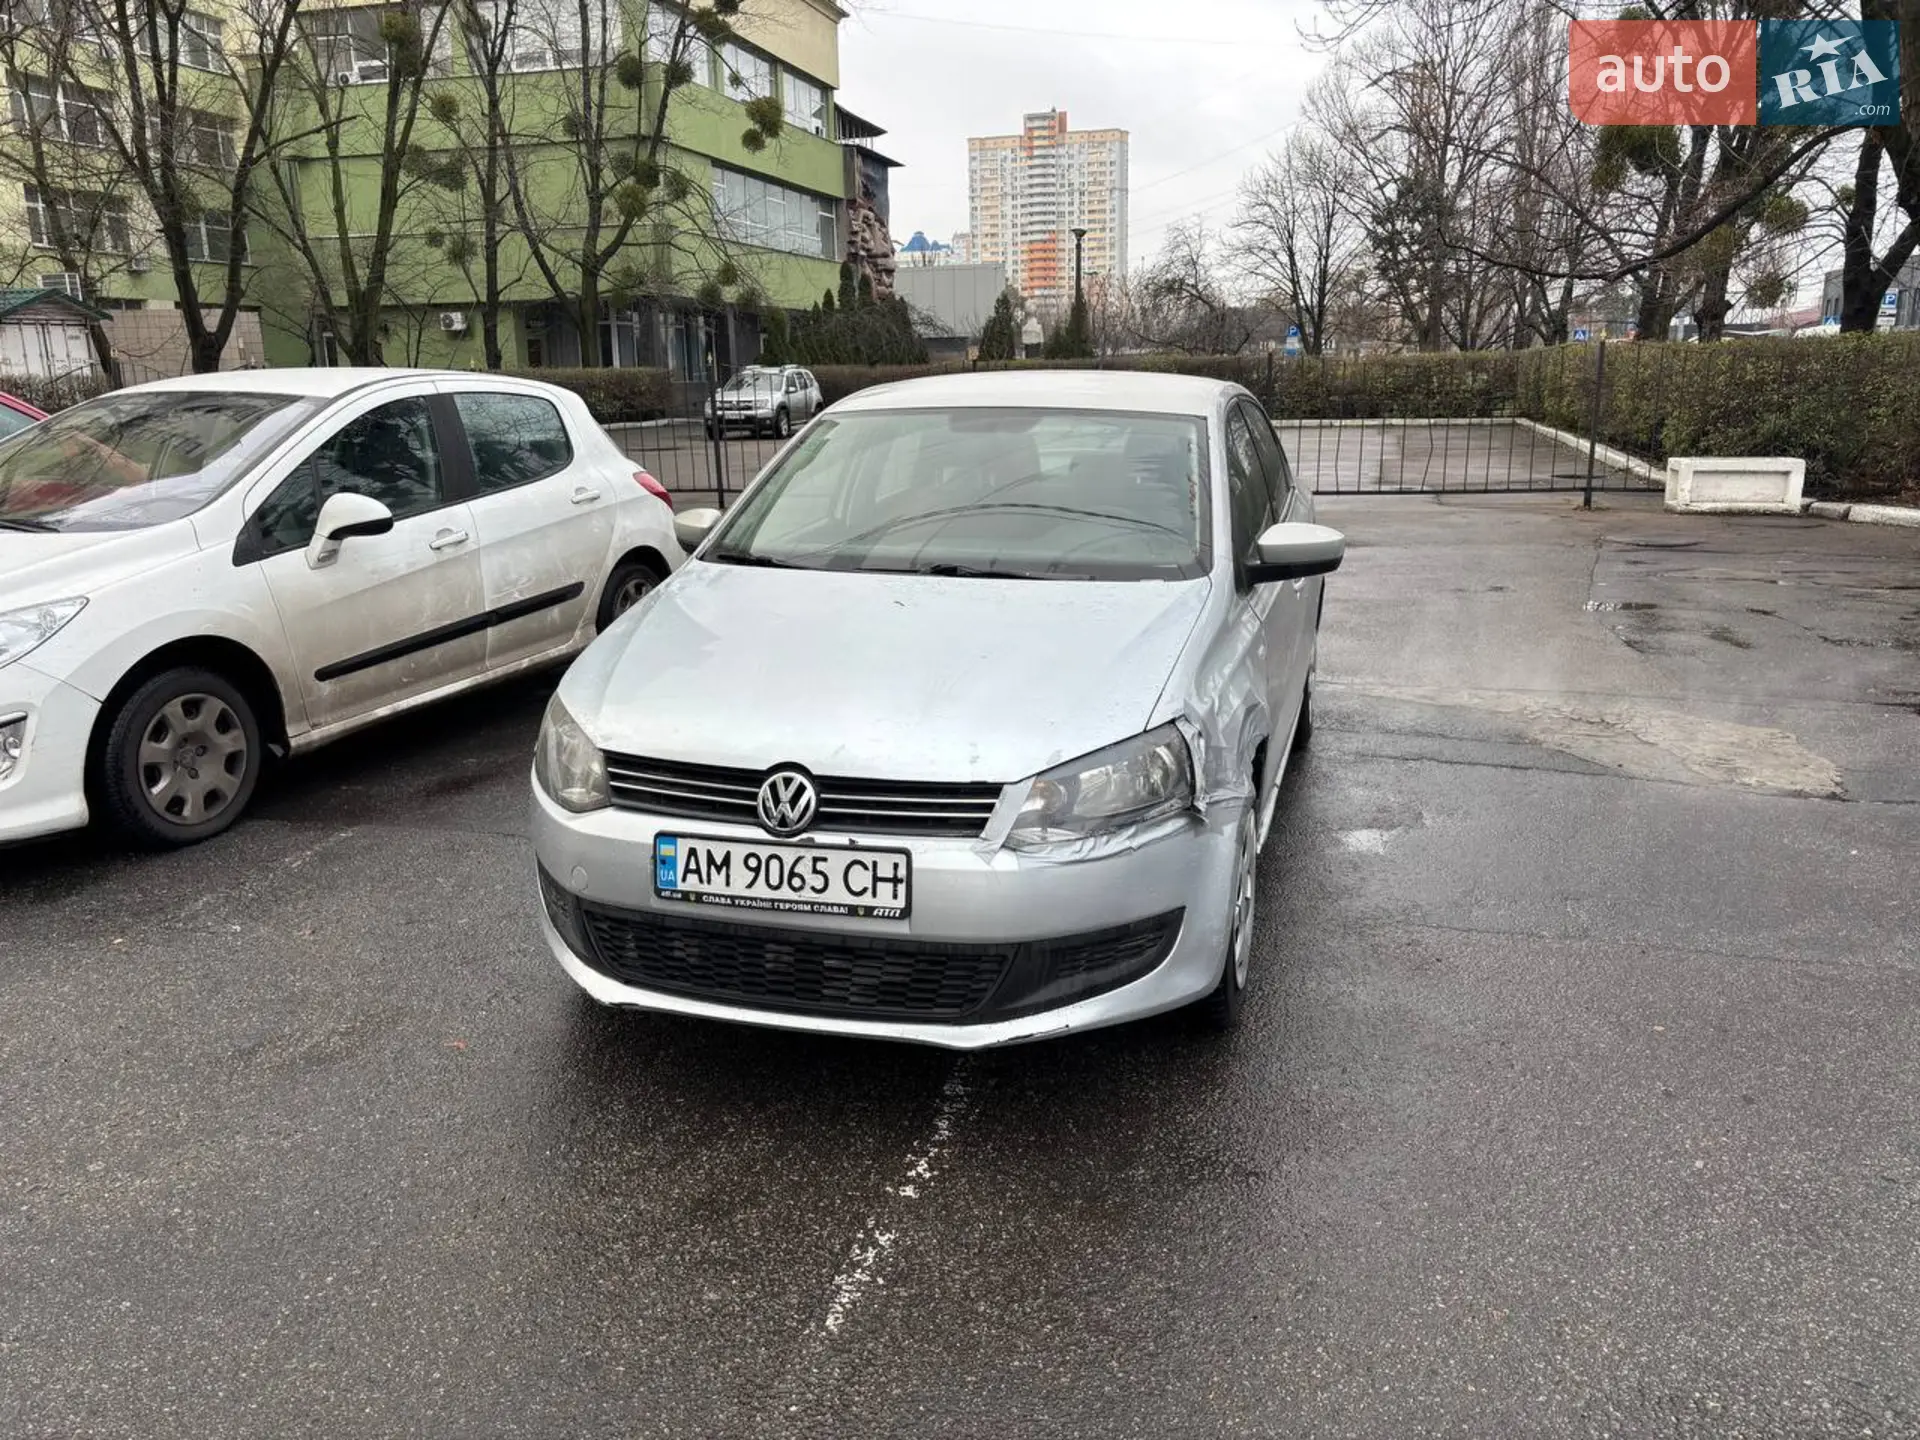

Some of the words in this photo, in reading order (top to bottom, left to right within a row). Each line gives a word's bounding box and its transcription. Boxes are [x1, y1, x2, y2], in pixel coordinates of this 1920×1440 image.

[660, 869, 676, 882] UA
[681, 846, 732, 888] AM
[743, 851, 829, 895] 9065
[842, 859, 900, 900] CH
[702, 894, 732, 905] СЛАВА
[773, 901, 812, 912] ГЕРОЯМ
